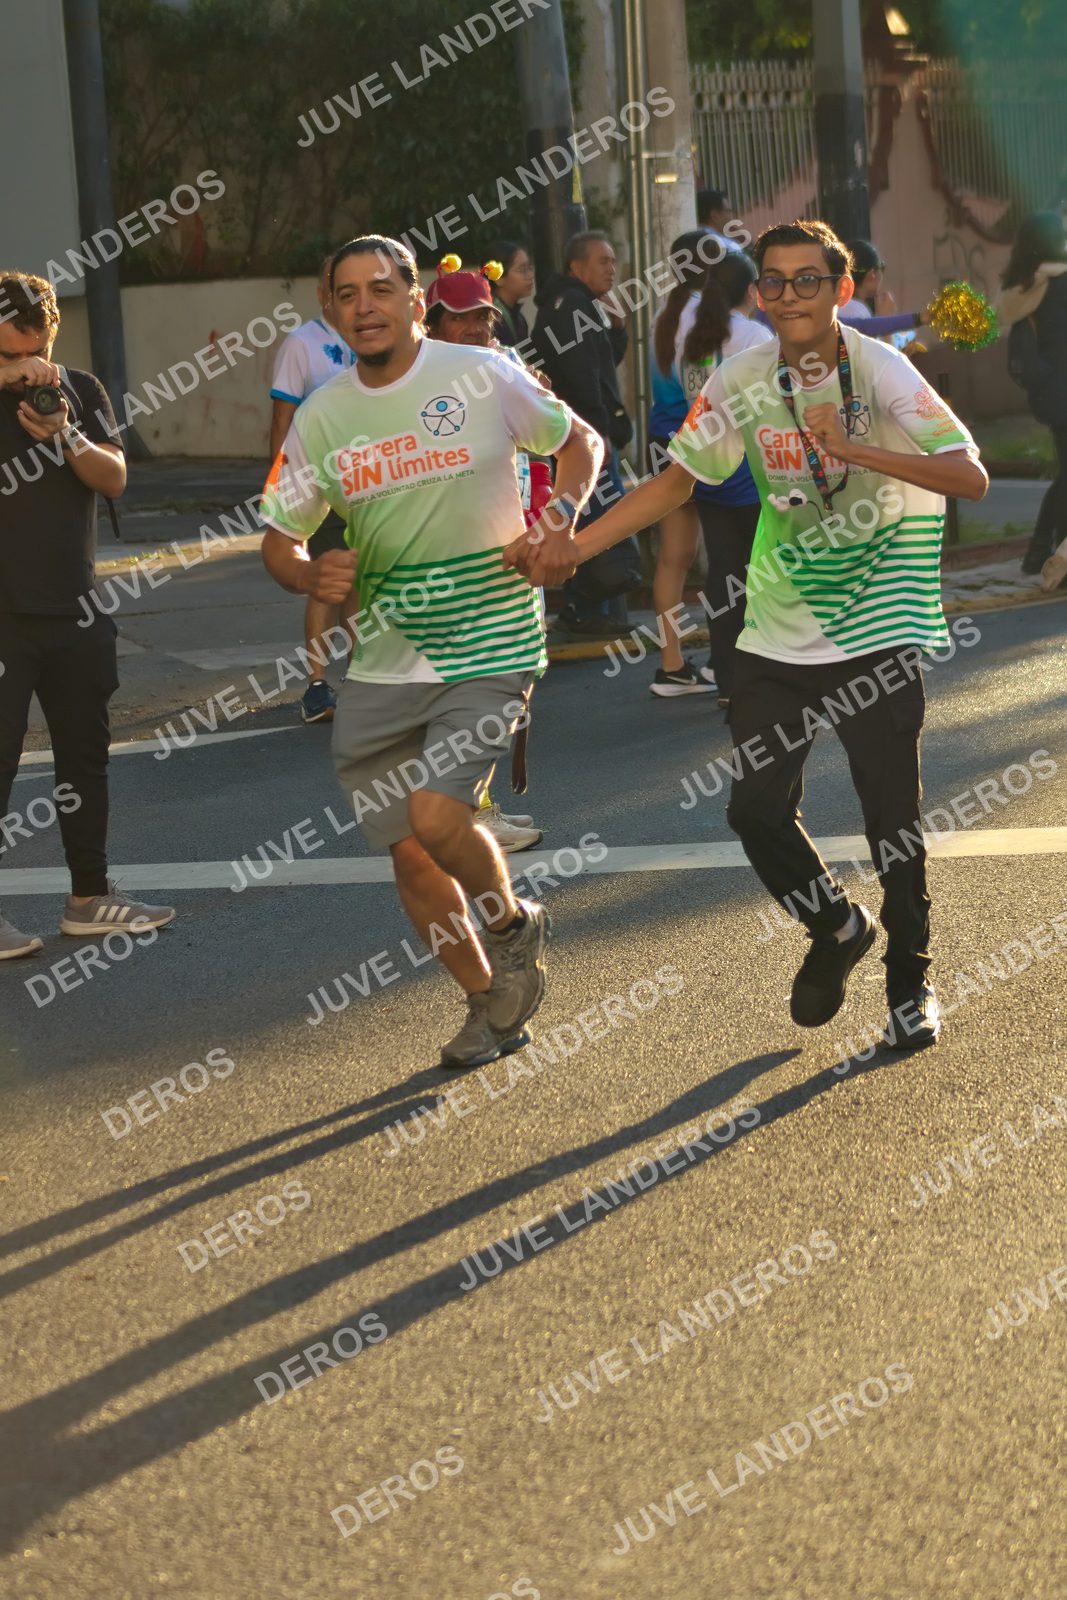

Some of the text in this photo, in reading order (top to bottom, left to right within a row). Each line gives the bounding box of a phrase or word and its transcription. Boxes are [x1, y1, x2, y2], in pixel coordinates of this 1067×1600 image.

[338, 434, 417, 472] Carrera
[759, 428, 820, 449] Carr
[342, 447, 470, 497] SIN límites
[765, 448, 802, 471] SIN
[376, 483, 416, 498] VOLUNTAD
[416, 475, 442, 488] CRUZA
[455, 469, 475, 479] META
